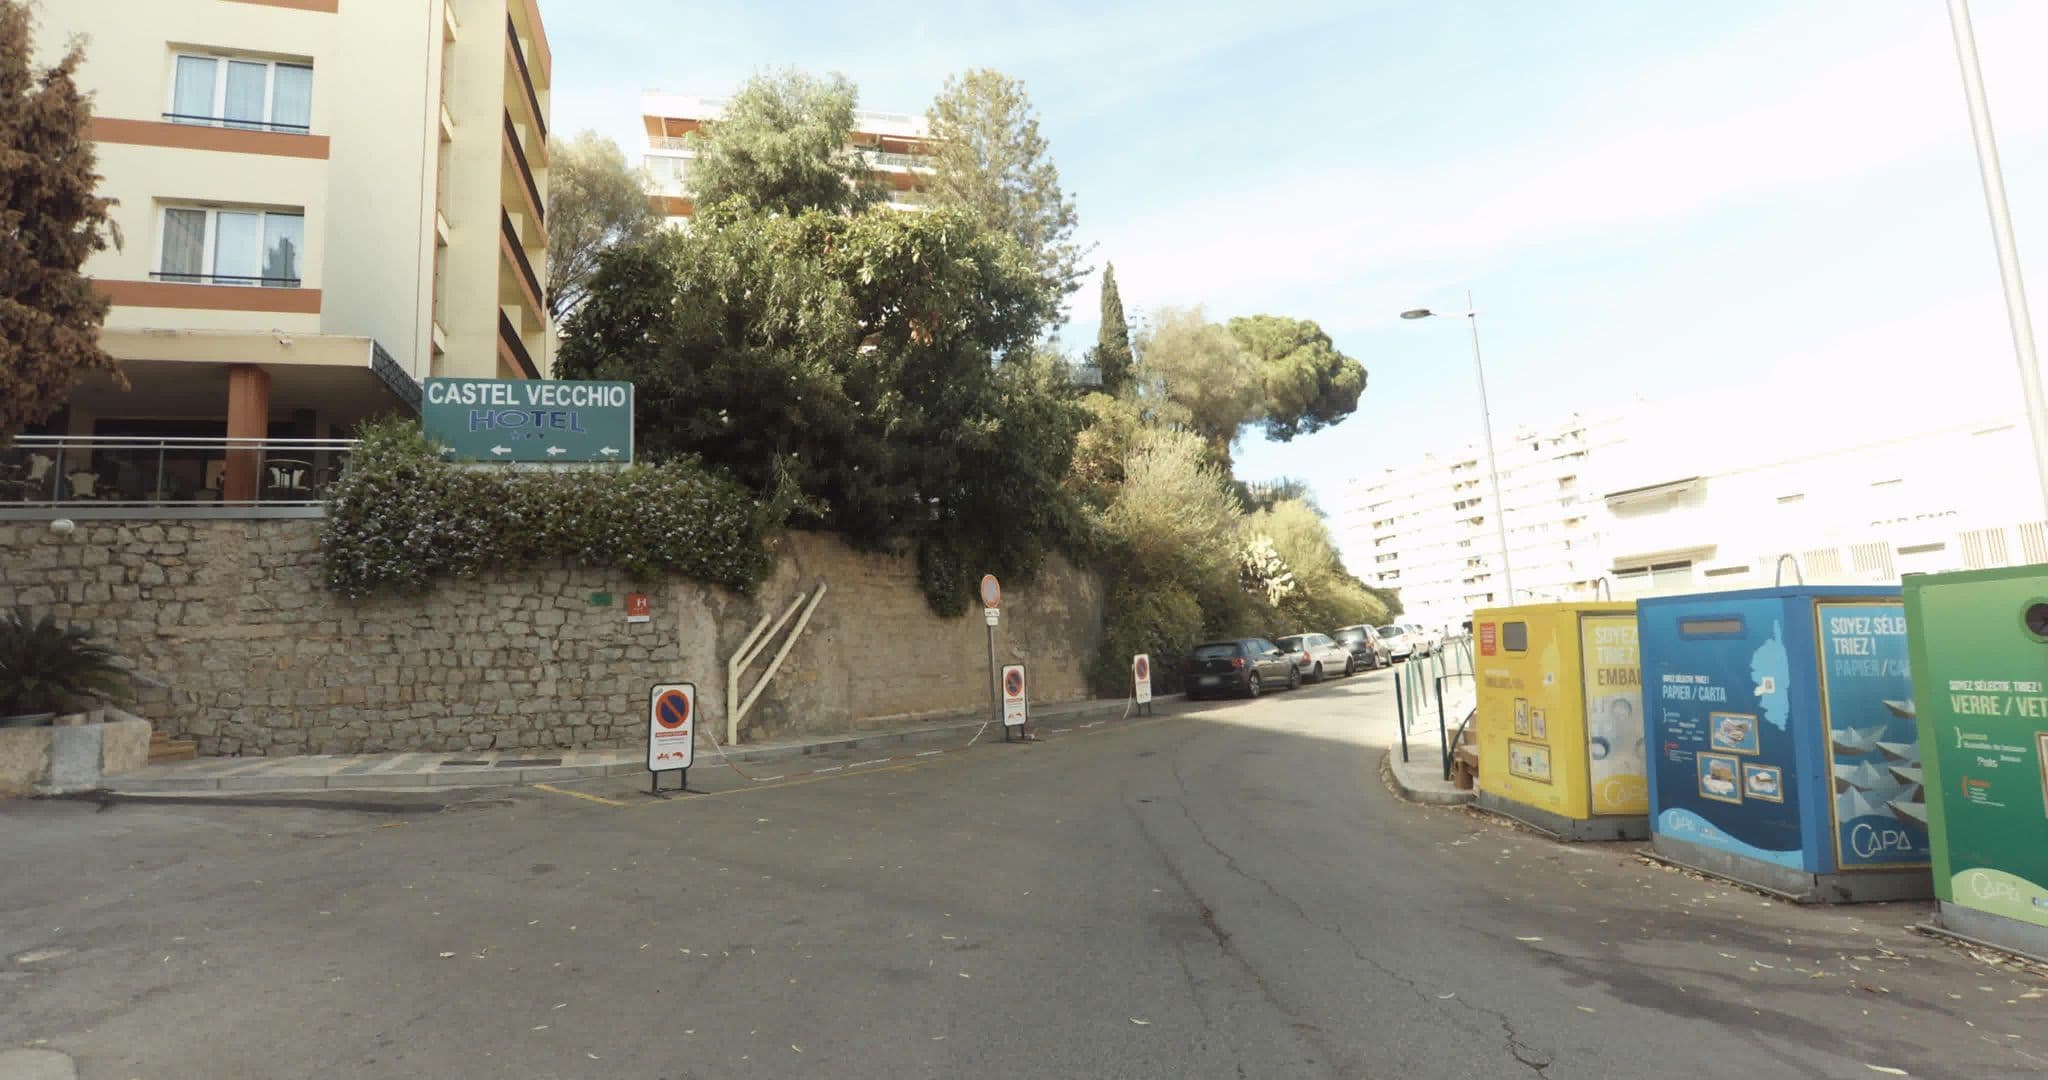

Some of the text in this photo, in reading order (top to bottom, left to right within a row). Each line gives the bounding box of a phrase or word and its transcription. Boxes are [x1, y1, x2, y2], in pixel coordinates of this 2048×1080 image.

[428, 383, 626, 407] CASTEL VECCHIO
[469, 410, 585, 432] HOTEL
[636, 598, 647, 607] H
[1830, 617, 1872, 635] SOYEZ
[1832, 637, 1870, 656] TRIEZ
[1662, 684, 1691, 700] PAPIER
[1698, 686, 1727, 703] CARTA
[1951, 694, 2001, 716] VERRE
[1851, 823, 1912, 858] CAPA
